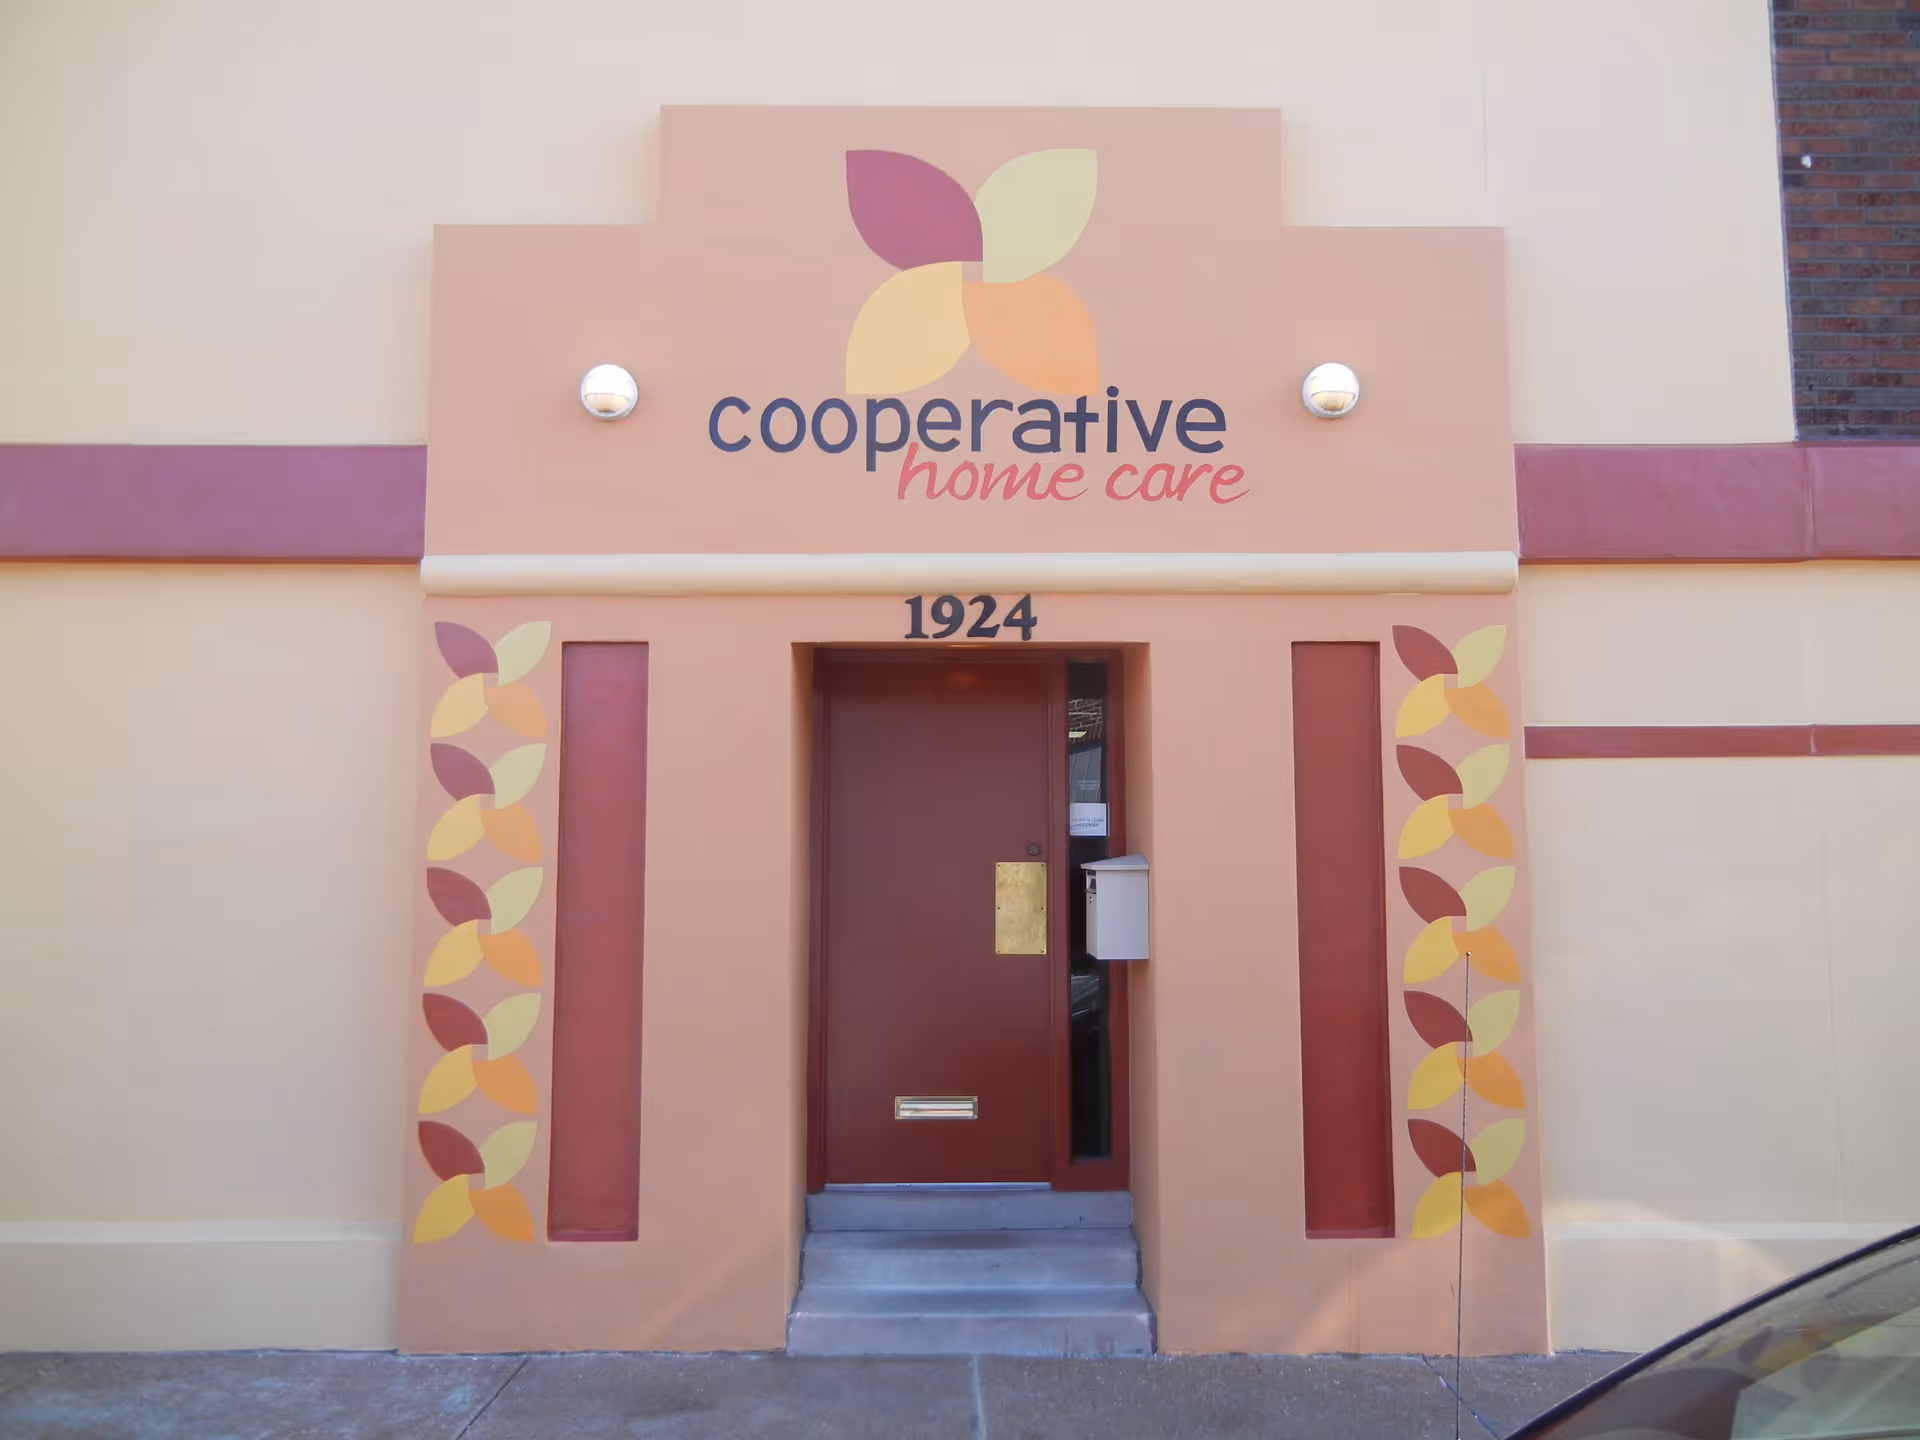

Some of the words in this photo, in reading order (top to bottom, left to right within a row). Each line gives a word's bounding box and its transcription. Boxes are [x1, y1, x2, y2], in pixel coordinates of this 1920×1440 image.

[708, 386, 1226, 471] cooperative
[897, 442, 1089, 501] home
[1105, 463, 1250, 504] care
[904, 594, 1038, 641] 1924
